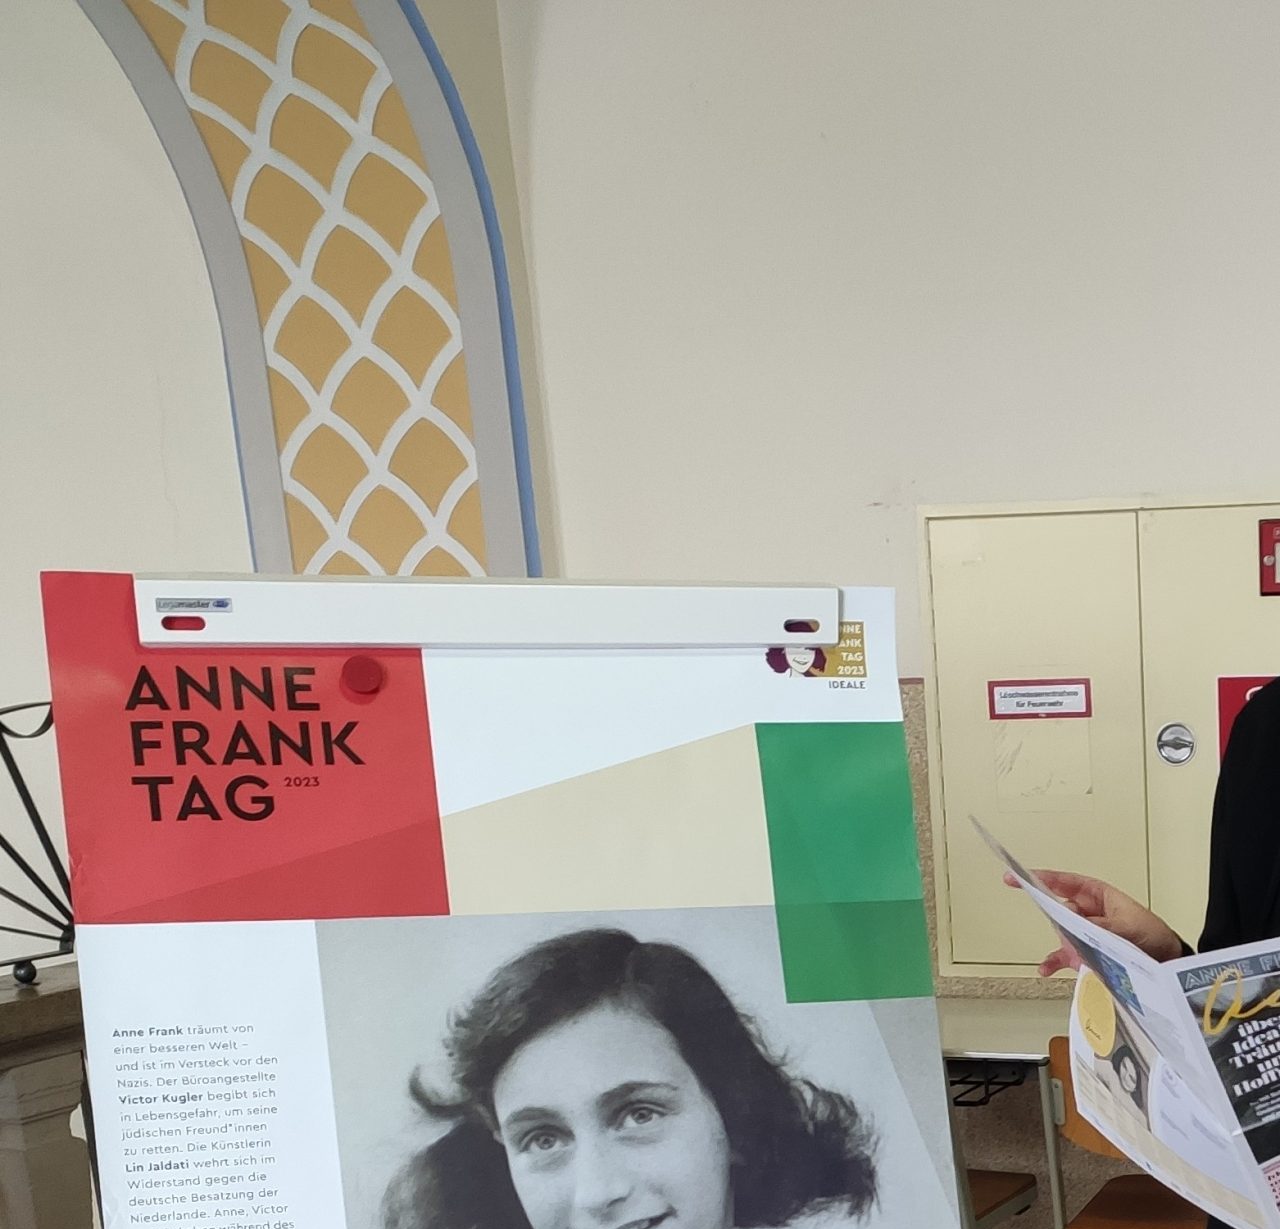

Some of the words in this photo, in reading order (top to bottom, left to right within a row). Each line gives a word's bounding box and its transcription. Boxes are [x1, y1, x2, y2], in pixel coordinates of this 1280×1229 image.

[841, 651, 863, 661] TAG
[837, 665, 865, 675] 2023
[125, 665, 320, 711] ANNE
[828, 680, 866, 689] IDEALE
[130, 720, 366, 766] FRANK
[132, 775, 275, 822] TAG
[284, 776, 320, 788] 2023
[1184, 962, 1254, 990] ANNE
[112, 1029, 144, 1037] Anne
[148, 1026, 183, 1036] Frank
[187, 1025, 228, 1034] träumt
[113, 1045, 145, 1054] einer
[149, 1044, 205, 1053] besseren
[208, 1041, 238, 1050] Welt
[115, 1062, 138, 1071] und
[142, 1061, 156, 1070] ist
[159, 1060, 175, 1069] im
[178, 1057, 229, 1068] Versteck
[255, 1056, 278, 1064] den
[116, 1078, 152, 1087] Nazis.
[156, 1077, 178, 1086] Der
[181, 1072, 276, 1085] Büroangestellte
[118, 1095, 158, 1104] Victor
[161, 1092, 203, 1104] Kugler
[207, 1090, 247, 1101] begibt
[252, 1088, 275, 1098] sich
[120, 1112, 131, 1121] in
[134, 1108, 220, 1121] Lebensgefahr,
[246, 1105, 278, 1115] seine
[121, 1128, 181, 1141] jüdischen
[141, 1146, 183, 1155] retten.
[187, 1142, 207, 1152] Die
[210, 1138, 271, 1150] Künstlerin
[125, 1163, 144, 1172] Lin
[147, 1159, 189, 1171] Jaldati
[192, 1158, 229, 1167] wehrt
[233, 1155, 257, 1165] sich
[261, 1155, 275, 1164] im
[126, 1177, 200, 1189] Widerstand
[204, 1176, 244, 1186] gegen
[247, 1172, 267, 1181] die
[128, 1195, 187, 1206] deutsche
[191, 1192, 254, 1202] Besatzung
[258, 1188, 278, 1197] der
[130, 1209, 210, 1223] Niederlande.
[213, 1209, 248, 1218] Anne,
[251, 1205, 288, 1214] Victor
